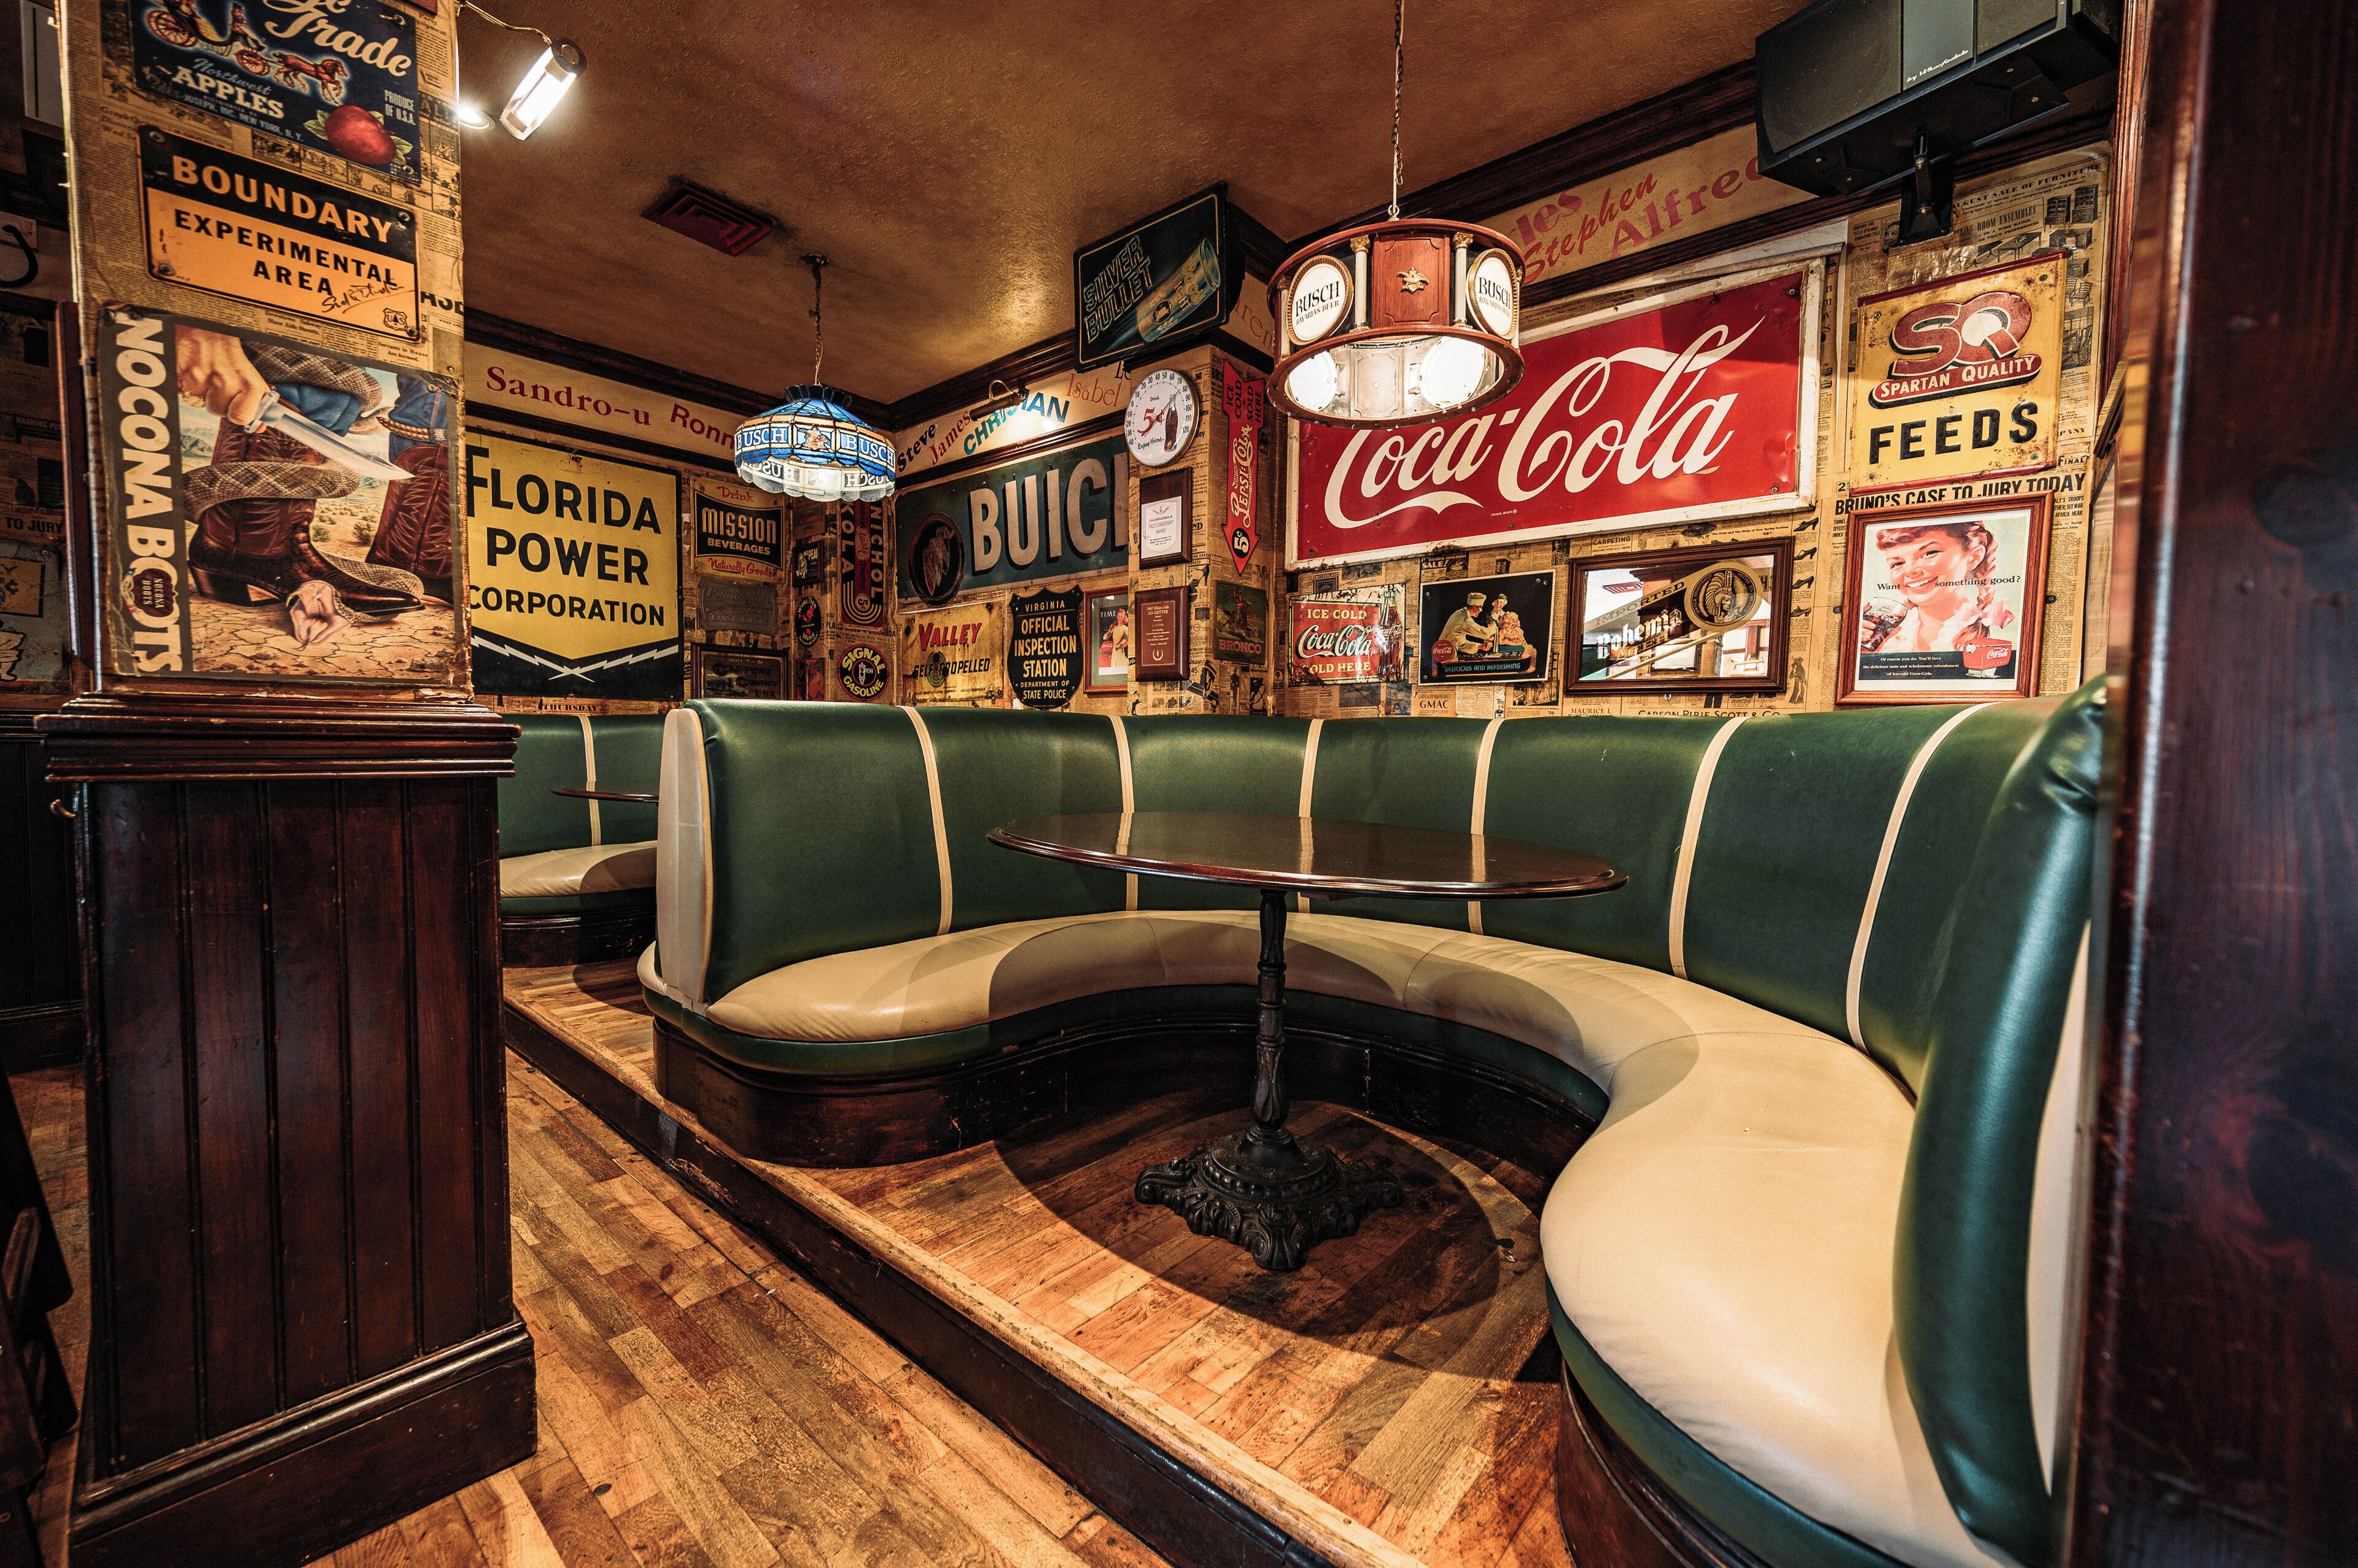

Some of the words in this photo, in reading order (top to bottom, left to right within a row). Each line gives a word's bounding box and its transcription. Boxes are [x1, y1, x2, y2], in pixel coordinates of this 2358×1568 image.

[263, 11, 413, 77] Trade
[172, 65, 284, 119] APPLES
[193, 58, 273, 96] Northwest
[384, 90, 416, 112] PRODUCE
[385, 103, 394, 117] OF
[172, 155, 394, 244] BOUNDARY
[1992, 186, 2018, 199] SALE
[1523, 173, 1657, 279] Stephen
[1977, 218, 1996, 231] ROOM
[1999, 205, 2036, 225] ENSEMBLES
[174, 208, 399, 287] EXPERIMENTAL
[254, 260, 334, 297] AREA
[1084, 235, 1144, 312] SILVER
[1086, 255, 1153, 344] BULLET
[1295, 280, 1340, 317] BUSCH
[1478, 276, 1511, 309] BUSCH
[1296, 308, 1321, 325] BAVARIAN
[1322, 299, 1339, 311] BEER
[1889, 289, 2033, 379] SQ
[1065, 373, 1124, 408] Isabel
[1880, 372, 1951, 398] SPARTAN
[1961, 355, 2036, 382] QUALITY
[1134, 390, 1140, 399] 10
[1185, 394, 1191, 402] 90
[115, 312, 173, 519] NOCONA
[1137, 406, 1165, 437] 5¢
[1324, 315, 1766, 530] Coca-Cola
[737, 427, 787, 451] BUSCH
[896, 422, 938, 473] Steve
[928, 409, 972, 466] James
[1868, 401, 2039, 465] FEEDS
[845, 434, 896, 467] BUSCH
[2057, 456, 2085, 466] FINAL
[465, 444, 662, 535] FLORIDA
[717, 485, 755, 503] Drink
[2026, 472, 2087, 495] TODAY
[701, 506, 777, 545] MISSION
[841, 501, 855, 574] KOLA
[1592, 536, 1632, 546] CARPETING
[486, 526, 650, 586] POWER
[707, 536, 771, 556] BEVERAGES
[870, 505, 883, 599] NICHOL
[1234, 530, 1250, 553] 5¢
[708, 556, 745, 576] Naturally
[1421, 559, 1449, 570] SALE!
[1737, 572, 1750, 584] HECHO
[1745, 596, 1754, 613] MEXICO
[1934, 578, 1986, 588] something
[1990, 575, 2021, 586] good?
[126, 524, 184, 673] BOOTS
[469, 585, 665, 627] CORPORATION
[1025, 600, 1065, 612] VIRGINIA
[1307, 608, 1329, 619] ICE
[1336, 609, 1368, 619] COLD
[1595, 581, 1685, 626] IMPORTED
[1021, 615, 1070, 635] OFFICIAL
[1867, 608, 1900, 625] Coca-Cola
[918, 622, 982, 652] VALLEY
[1014, 635, 1076, 657] INSPECTION
[1218, 638, 1263, 654] BRONCO
[1294, 624, 1375, 659] Coca-Cola
[842, 647, 885, 674] SIGNAL
[1022, 658, 1067, 678] STATION
[1986, 647, 2010, 660] Coca-Cola
[843, 675, 884, 697] GASOLINE
[1022, 691, 1041, 700] STATE
[1044, 689, 1067, 699] POLICE
[1419, 699, 1449, 709] GMAC
